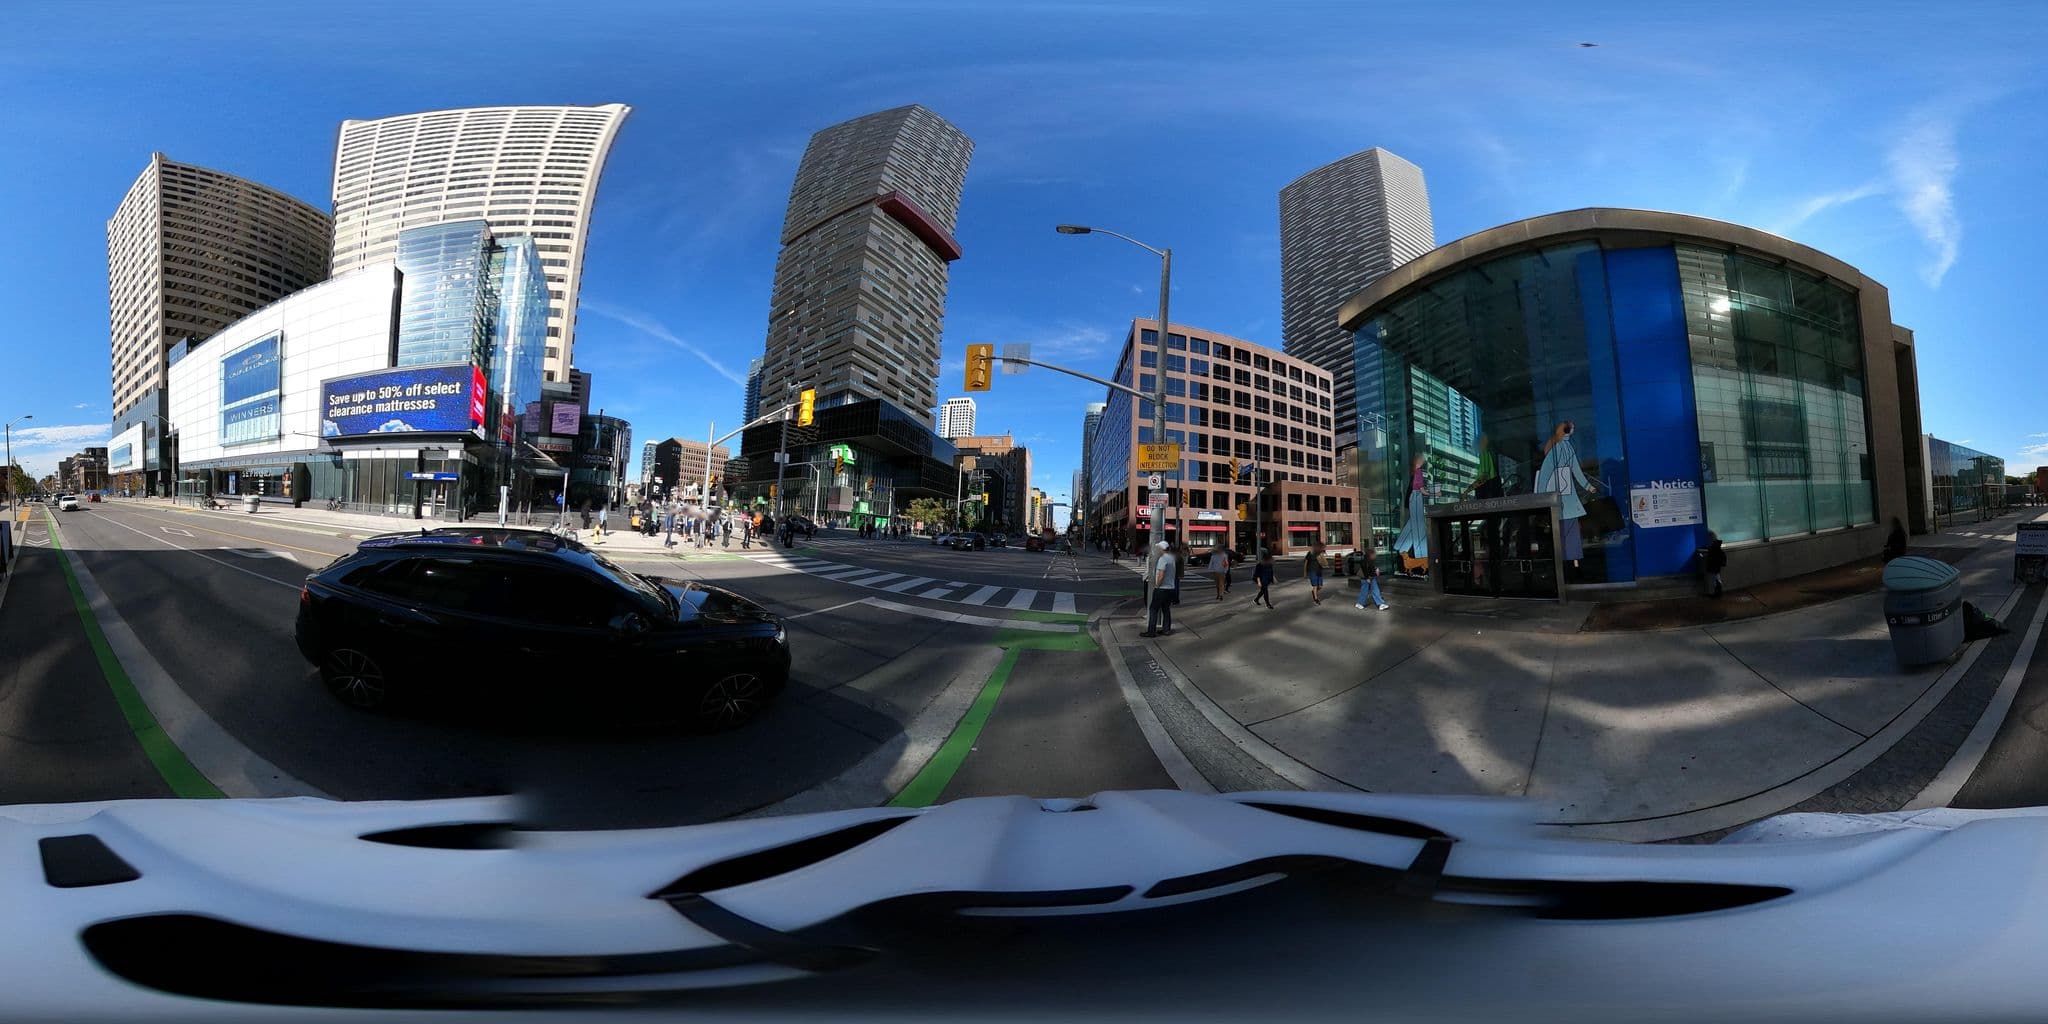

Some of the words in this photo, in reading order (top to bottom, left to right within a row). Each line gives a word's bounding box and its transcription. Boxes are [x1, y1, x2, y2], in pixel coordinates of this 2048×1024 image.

[329, 394, 350, 406] Save
[352, 392, 364, 404] up
[366, 389, 376, 401] to
[378, 385, 403, 399] 50%
[406, 383, 423, 396] off
[424, 382, 461, 395] select
[230, 404, 273, 422] WINNERS
[329, 405, 373, 418] clearance
[375, 399, 436, 413] mattresses
[1139, 461, 1178, 469] INTERSECTION
[1651, 478, 1695, 489] Notice
[1138, 507, 1152, 516] CIB
